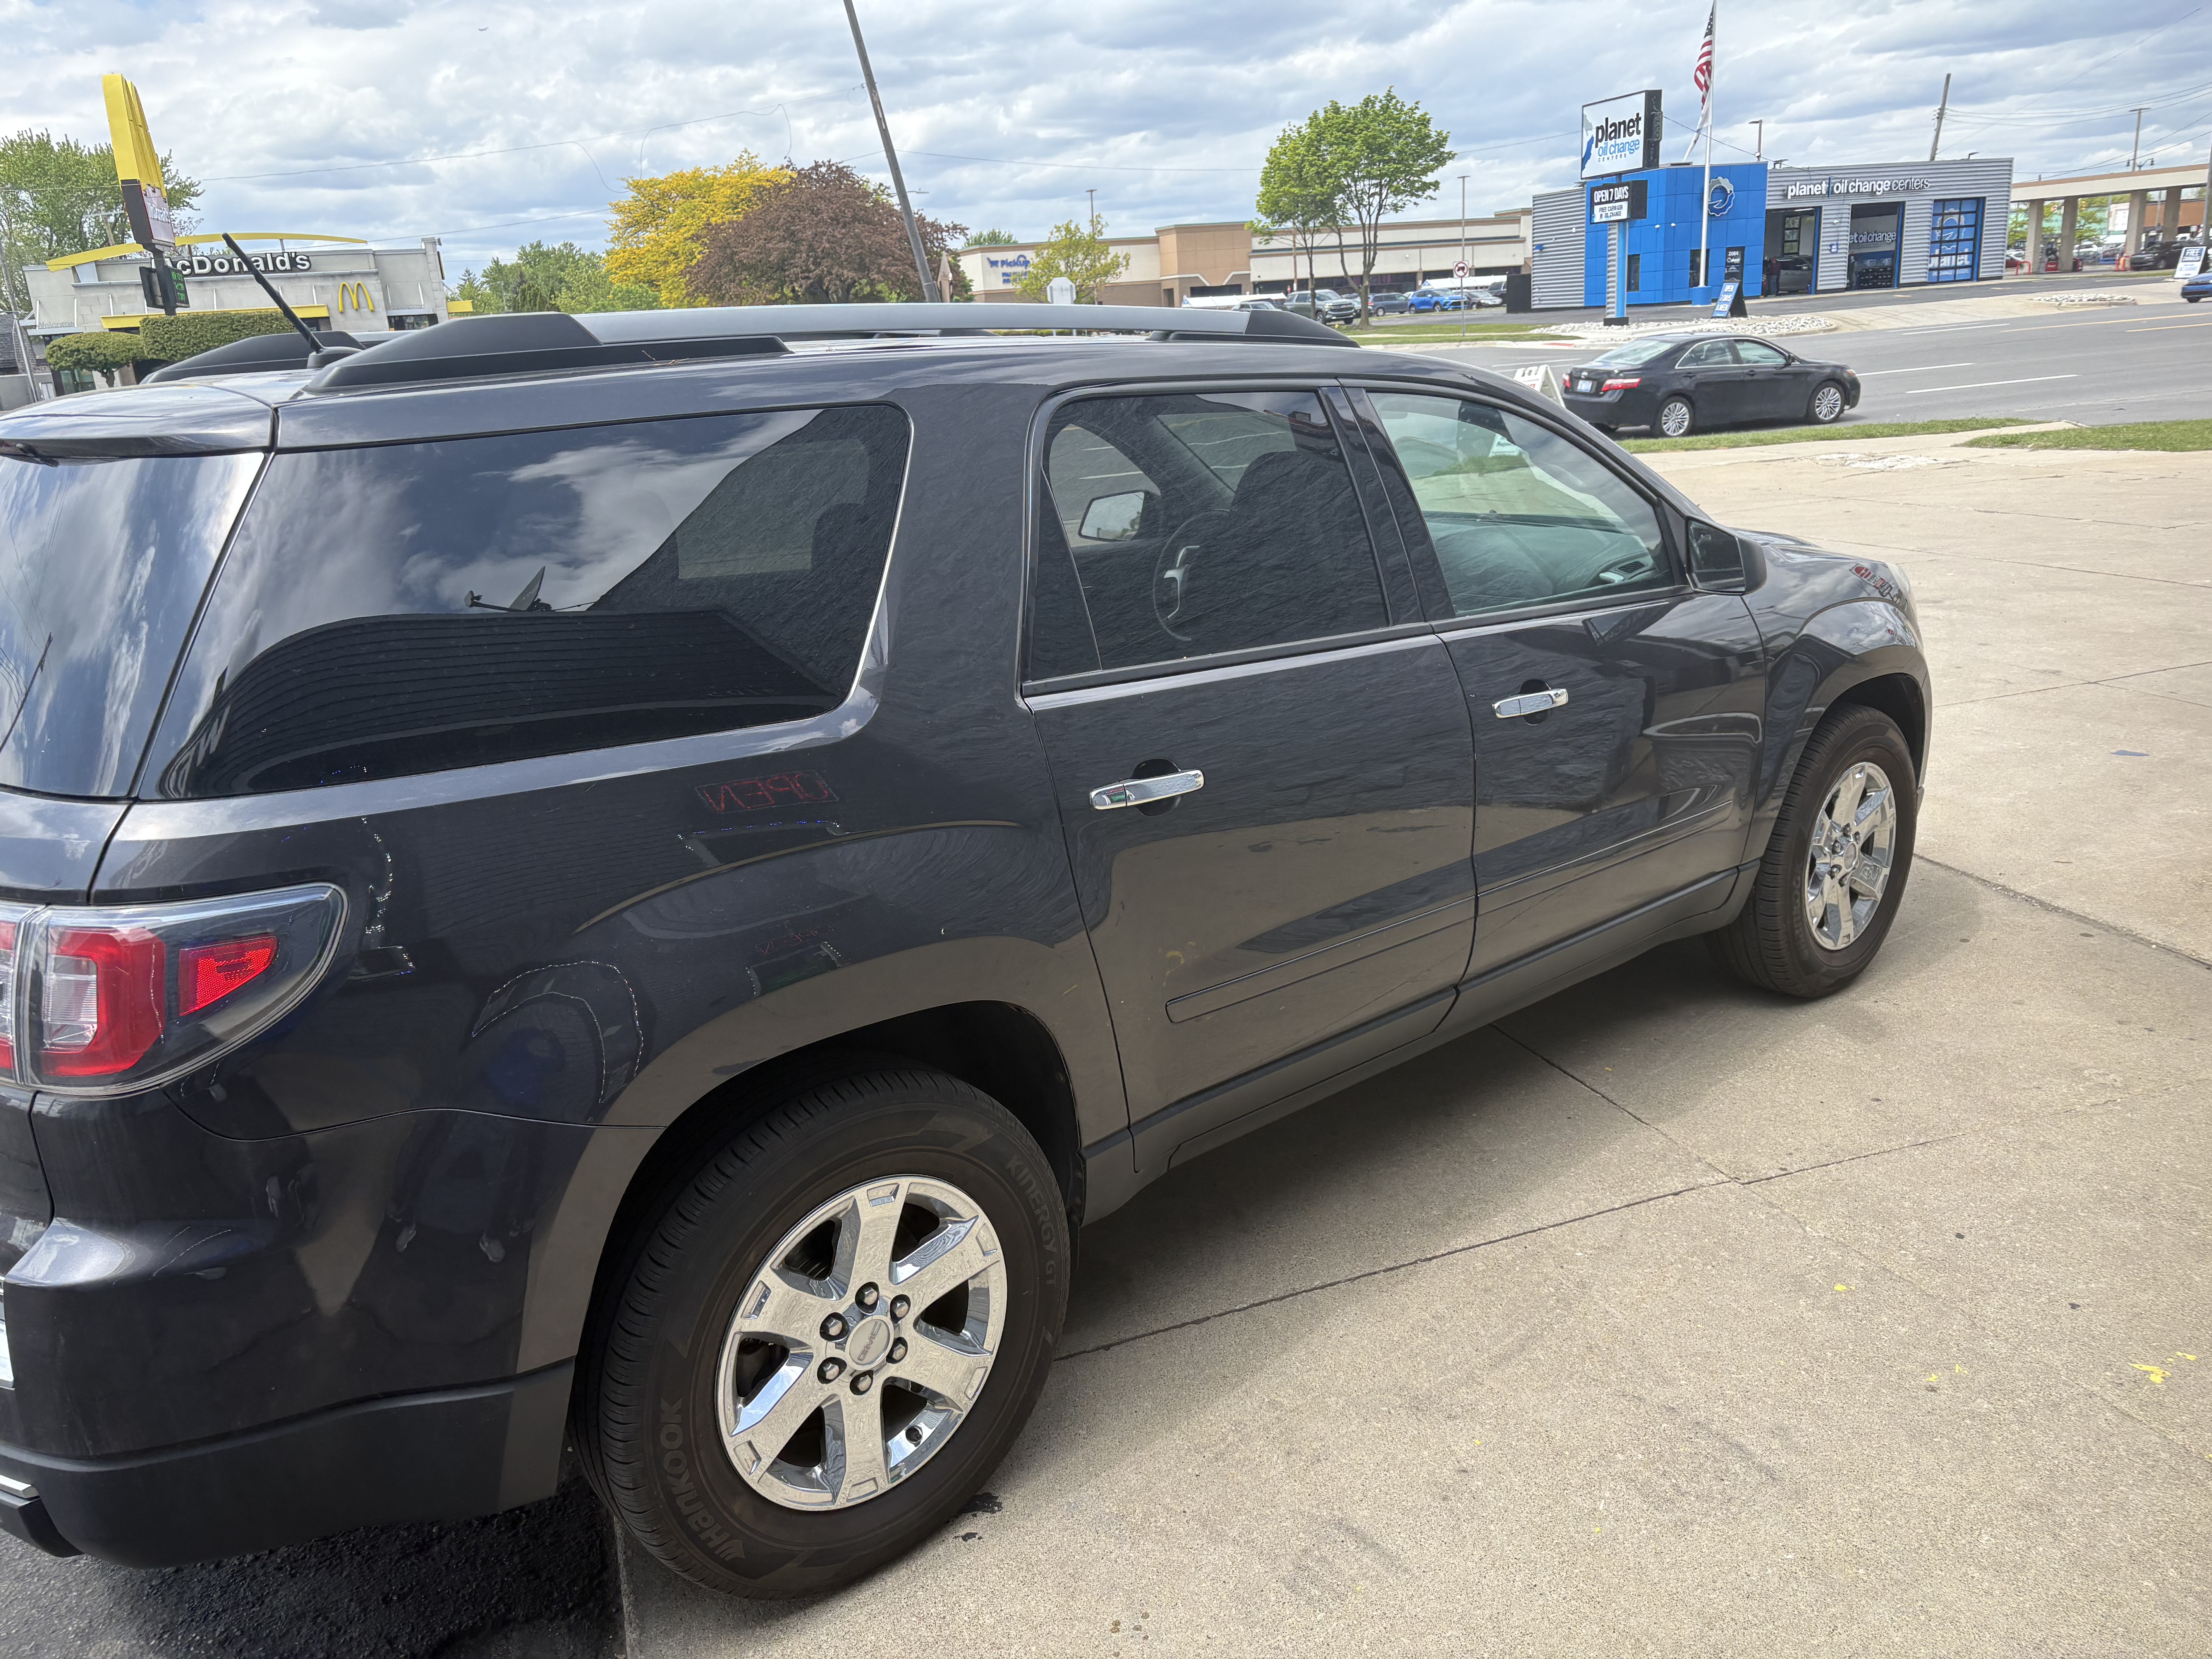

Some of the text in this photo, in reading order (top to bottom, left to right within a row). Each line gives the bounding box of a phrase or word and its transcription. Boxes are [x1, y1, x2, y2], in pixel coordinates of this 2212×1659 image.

[1595, 113, 1642, 148] planet
[1598, 139, 1640, 156] oil change
[1598, 153, 1626, 162] CENTERS
[1594, 186, 1629, 203] OPEN 7 DAYS
[1788, 177, 1930, 199] planet oil change centers
[1868, 231, 1896, 243] change
[1005, 1154, 1057, 1286] KINERGY GT
[857, 1321, 882, 1362] GMC
